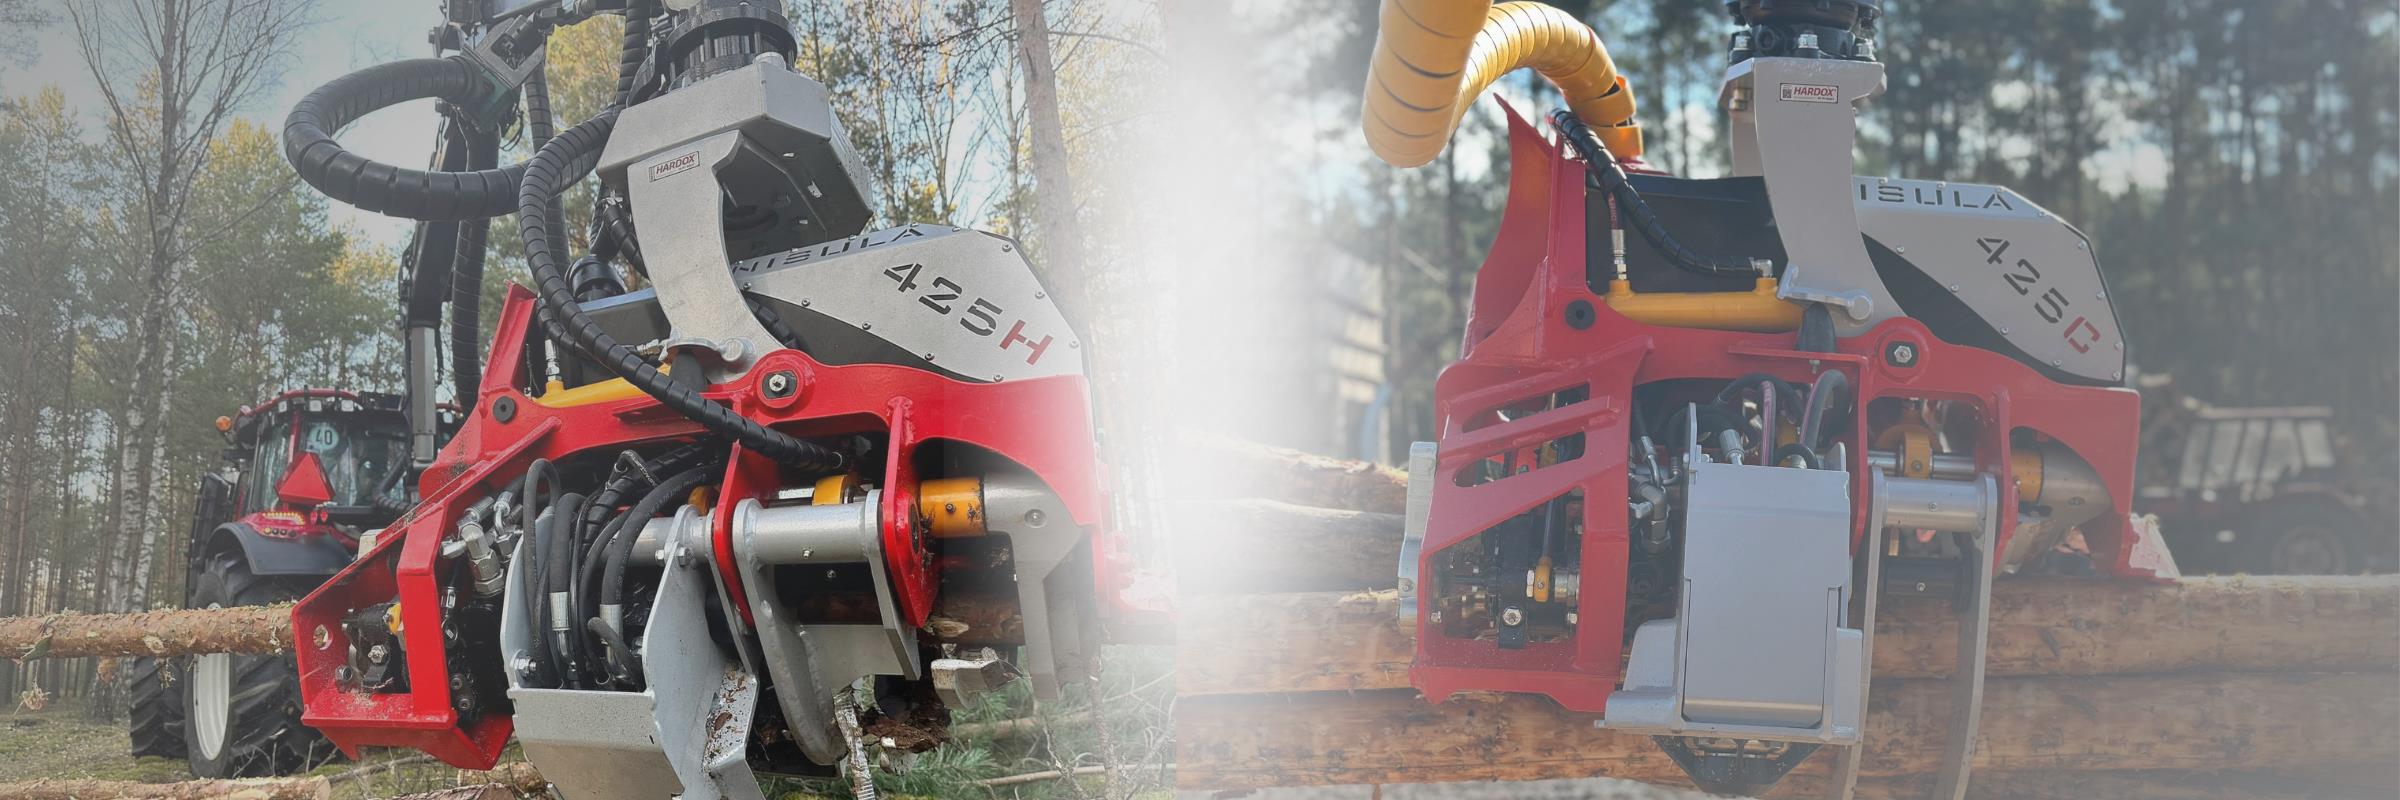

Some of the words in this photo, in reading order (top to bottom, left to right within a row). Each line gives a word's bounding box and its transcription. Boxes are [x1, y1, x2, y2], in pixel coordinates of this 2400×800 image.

[1793, 86, 1834, 97] HARDOX
[656, 154, 695, 175] HARDOX
[1860, 183, 2014, 211] ISULA
[1976, 237, 2101, 354] 425C
[883, 262, 1054, 366] 425H
[315, 430, 333, 446] 40
